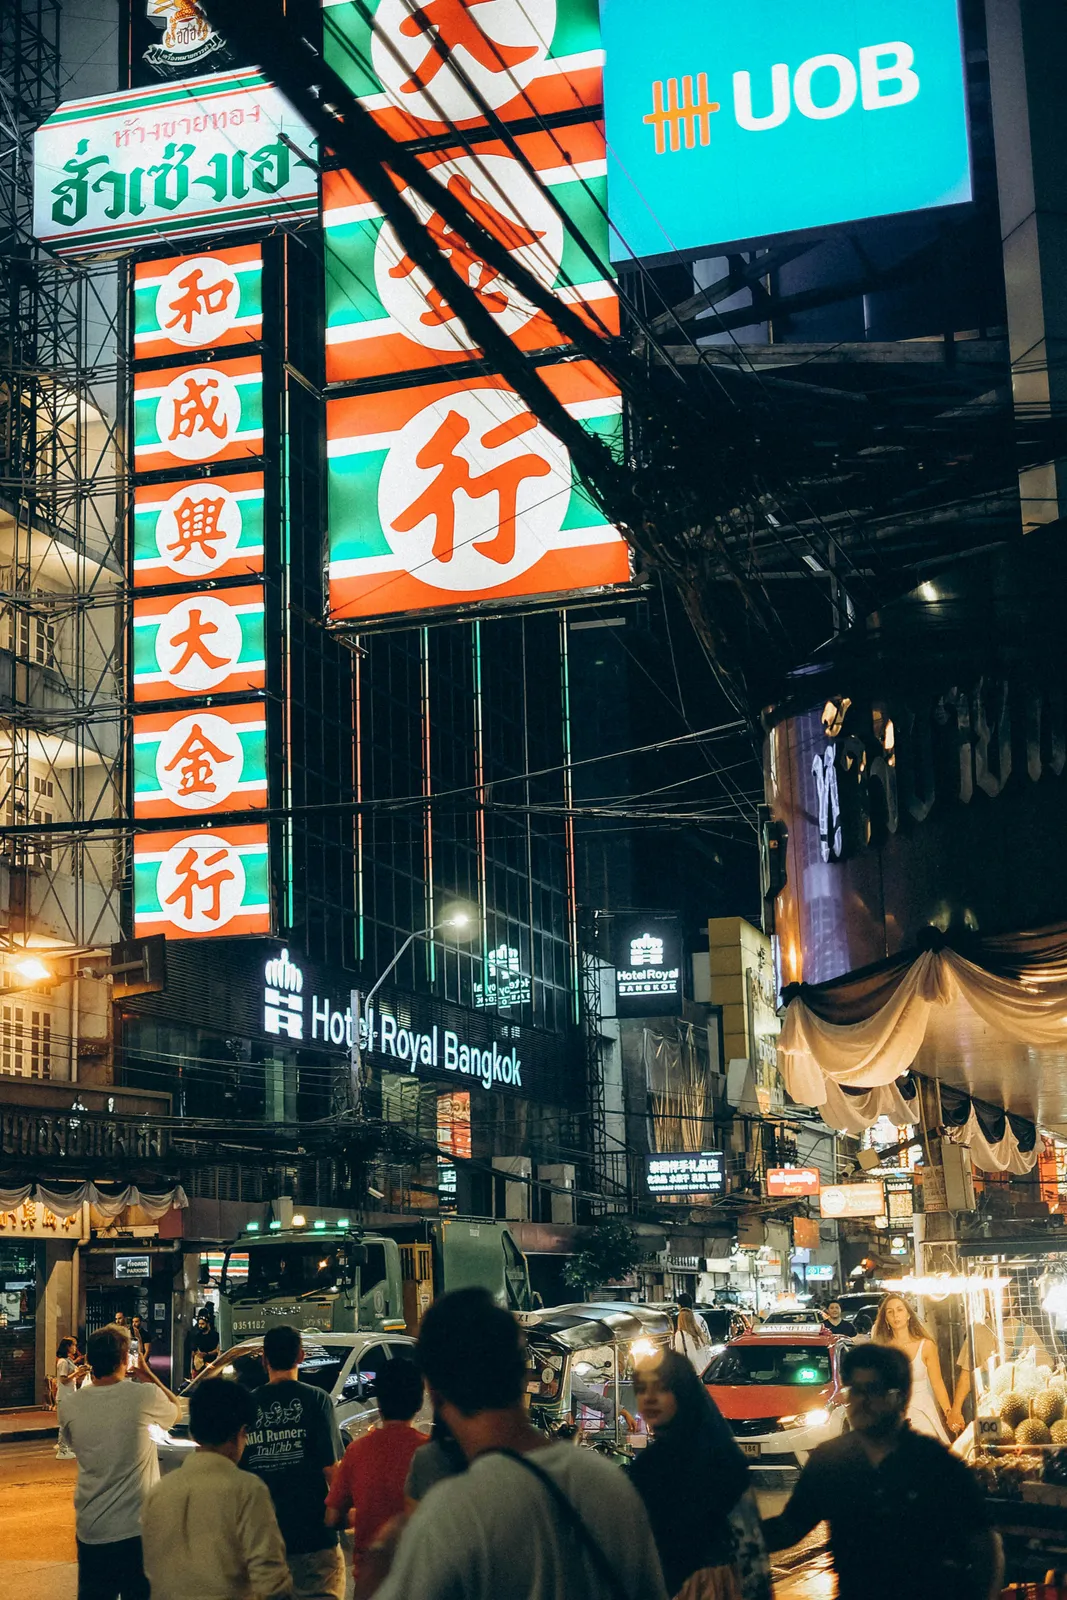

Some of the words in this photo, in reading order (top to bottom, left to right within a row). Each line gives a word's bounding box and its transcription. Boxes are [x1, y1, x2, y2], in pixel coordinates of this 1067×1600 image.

[732, 41, 920, 131] UOB
[113, 104, 261, 148] ห้างขายทอง
[617, 969, 646, 981] Hotel
[647, 968, 679, 981] Royal
[619, 983, 677, 992] BANGKOK
[381, 1013, 438, 1073] Royal
[444, 1031, 522, 1090] Bangkok
[232, 1320, 266, 1331] 0351182
[978, 1421, 998, 1434] 100
[257, 1444, 276, 1456] Trail
